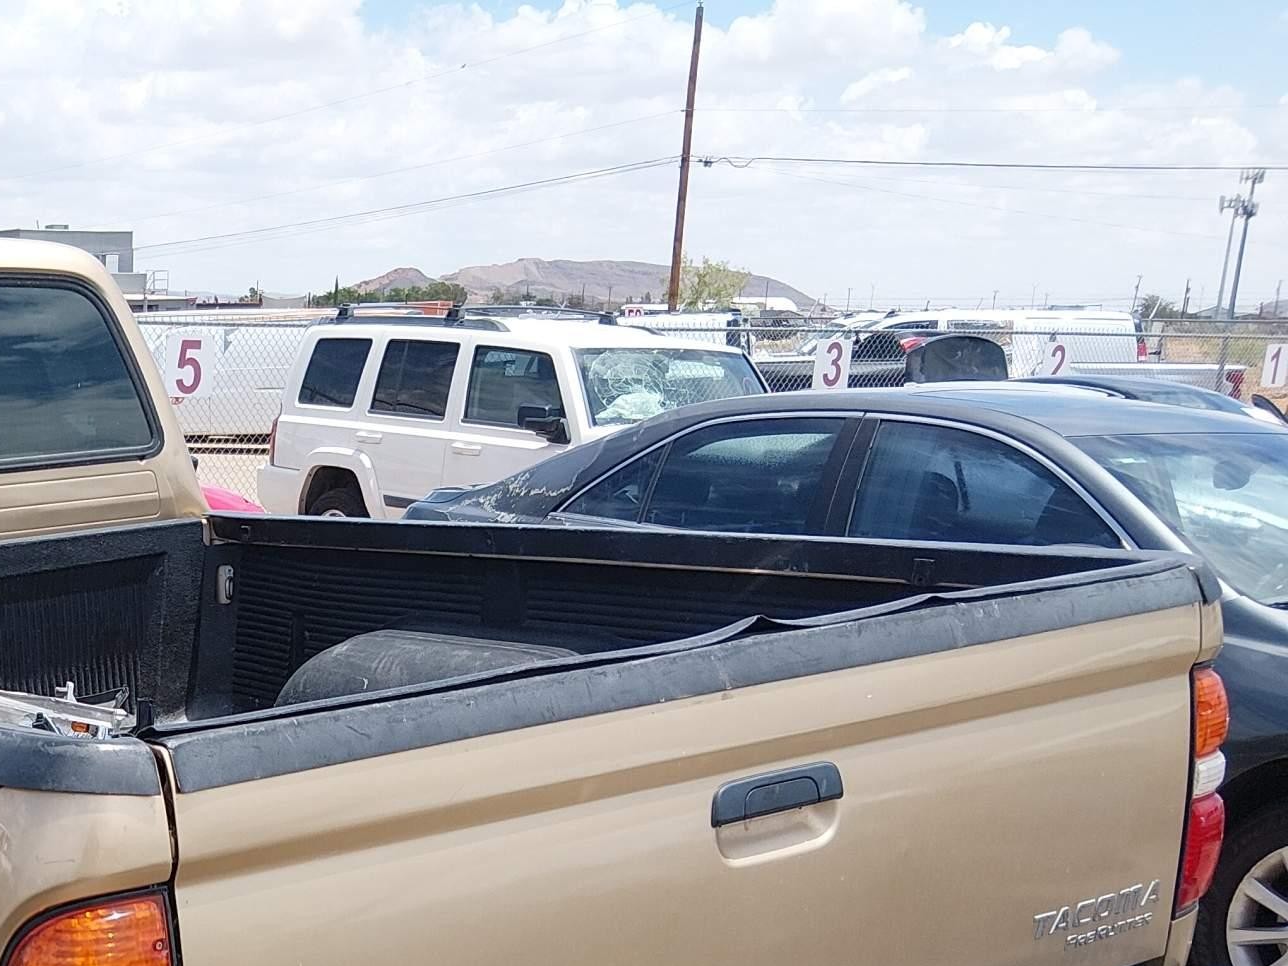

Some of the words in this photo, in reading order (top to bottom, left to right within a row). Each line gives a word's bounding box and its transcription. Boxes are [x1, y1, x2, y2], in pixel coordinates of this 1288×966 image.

[175, 339, 202, 395] 5
[822, 341, 843, 387] 3
[1050, 344, 1066, 376] 2
[1270, 346, 1283, 385] 1
[1032, 879, 1161, 941] TACOMA
